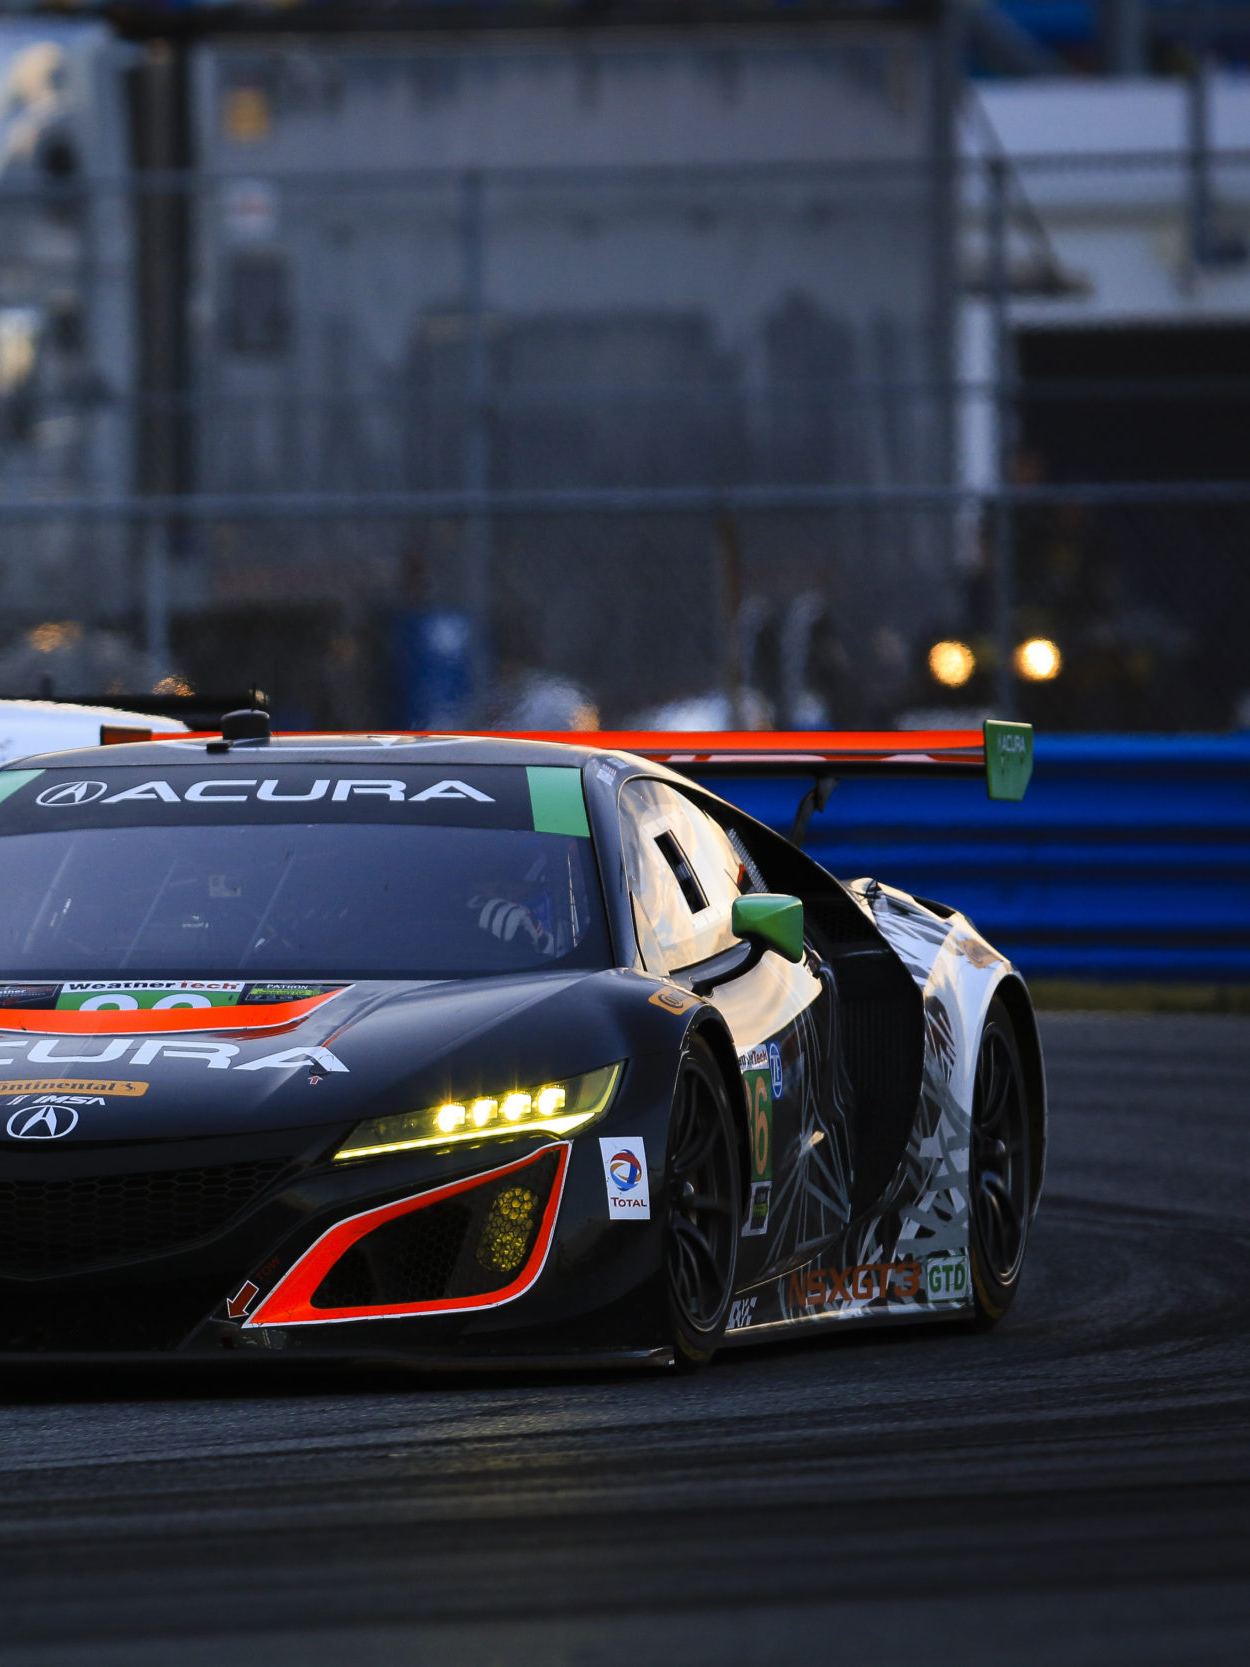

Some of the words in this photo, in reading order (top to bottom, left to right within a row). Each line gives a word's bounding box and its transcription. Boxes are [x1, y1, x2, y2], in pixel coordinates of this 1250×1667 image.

[100, 779, 496, 802] ACURA
[69, 981, 239, 991] WeatherTech
[32, 1095, 106, 1106] IMSA
[745, 1076, 769, 1176] 6
[928, 1263, 966, 1293] GTD
